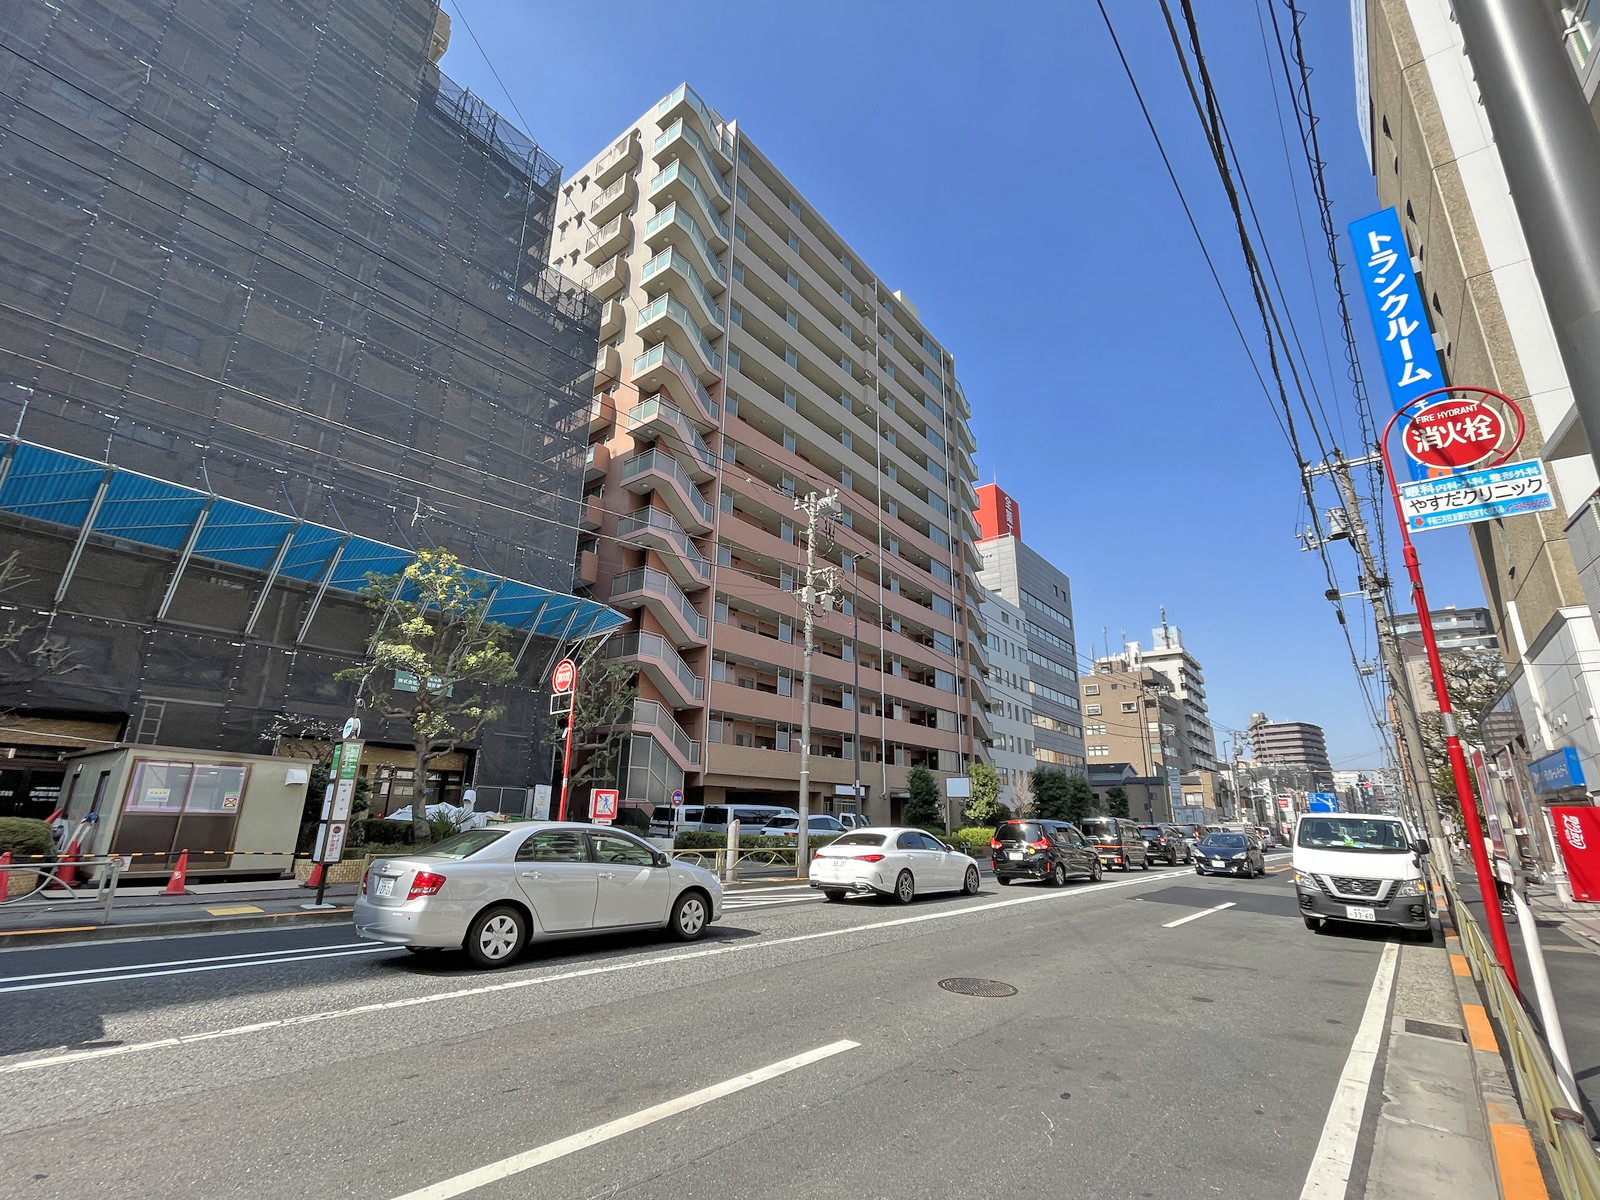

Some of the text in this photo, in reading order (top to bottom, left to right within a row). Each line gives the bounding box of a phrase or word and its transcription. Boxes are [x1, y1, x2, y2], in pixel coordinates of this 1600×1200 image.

[1367, 230, 1433, 388] トランクルーム
[1415, 413, 1436, 424] FIRE
[1437, 403, 1479, 420] HYDRANT
[1411, 414, 1497, 454] 消火栓
[1409, 478, 1543, 514] やすだクリニック
[1353, 911, 1374, 920] 33-60
